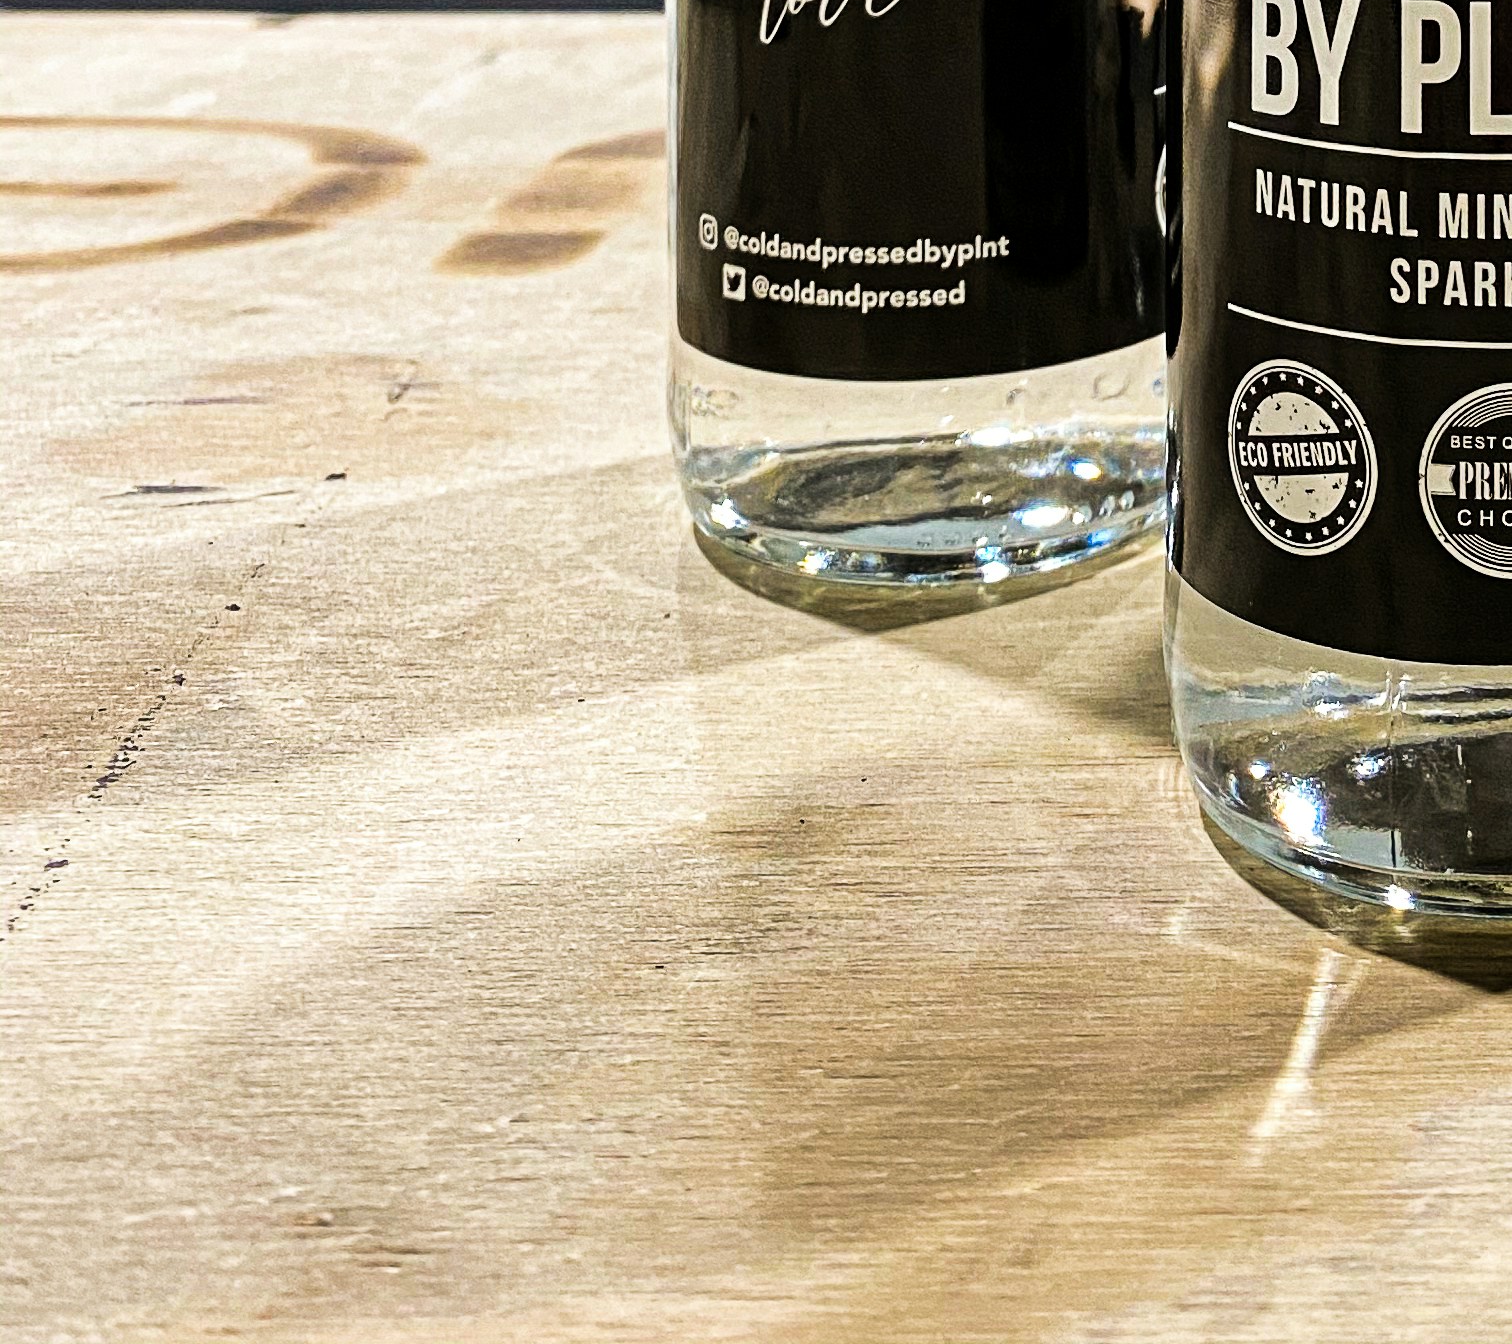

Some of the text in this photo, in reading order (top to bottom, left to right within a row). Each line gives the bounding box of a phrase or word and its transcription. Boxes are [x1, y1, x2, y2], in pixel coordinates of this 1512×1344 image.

[1254, 168, 1419, 238] NATURAL
[724, 225, 1010, 269] @coldandpressedbyplnt
[752, 273, 966, 314] @coldandpressed
[1238, 439, 1358, 468] ECO FRIENDLY
[1450, 434, 1497, 450] BEST
